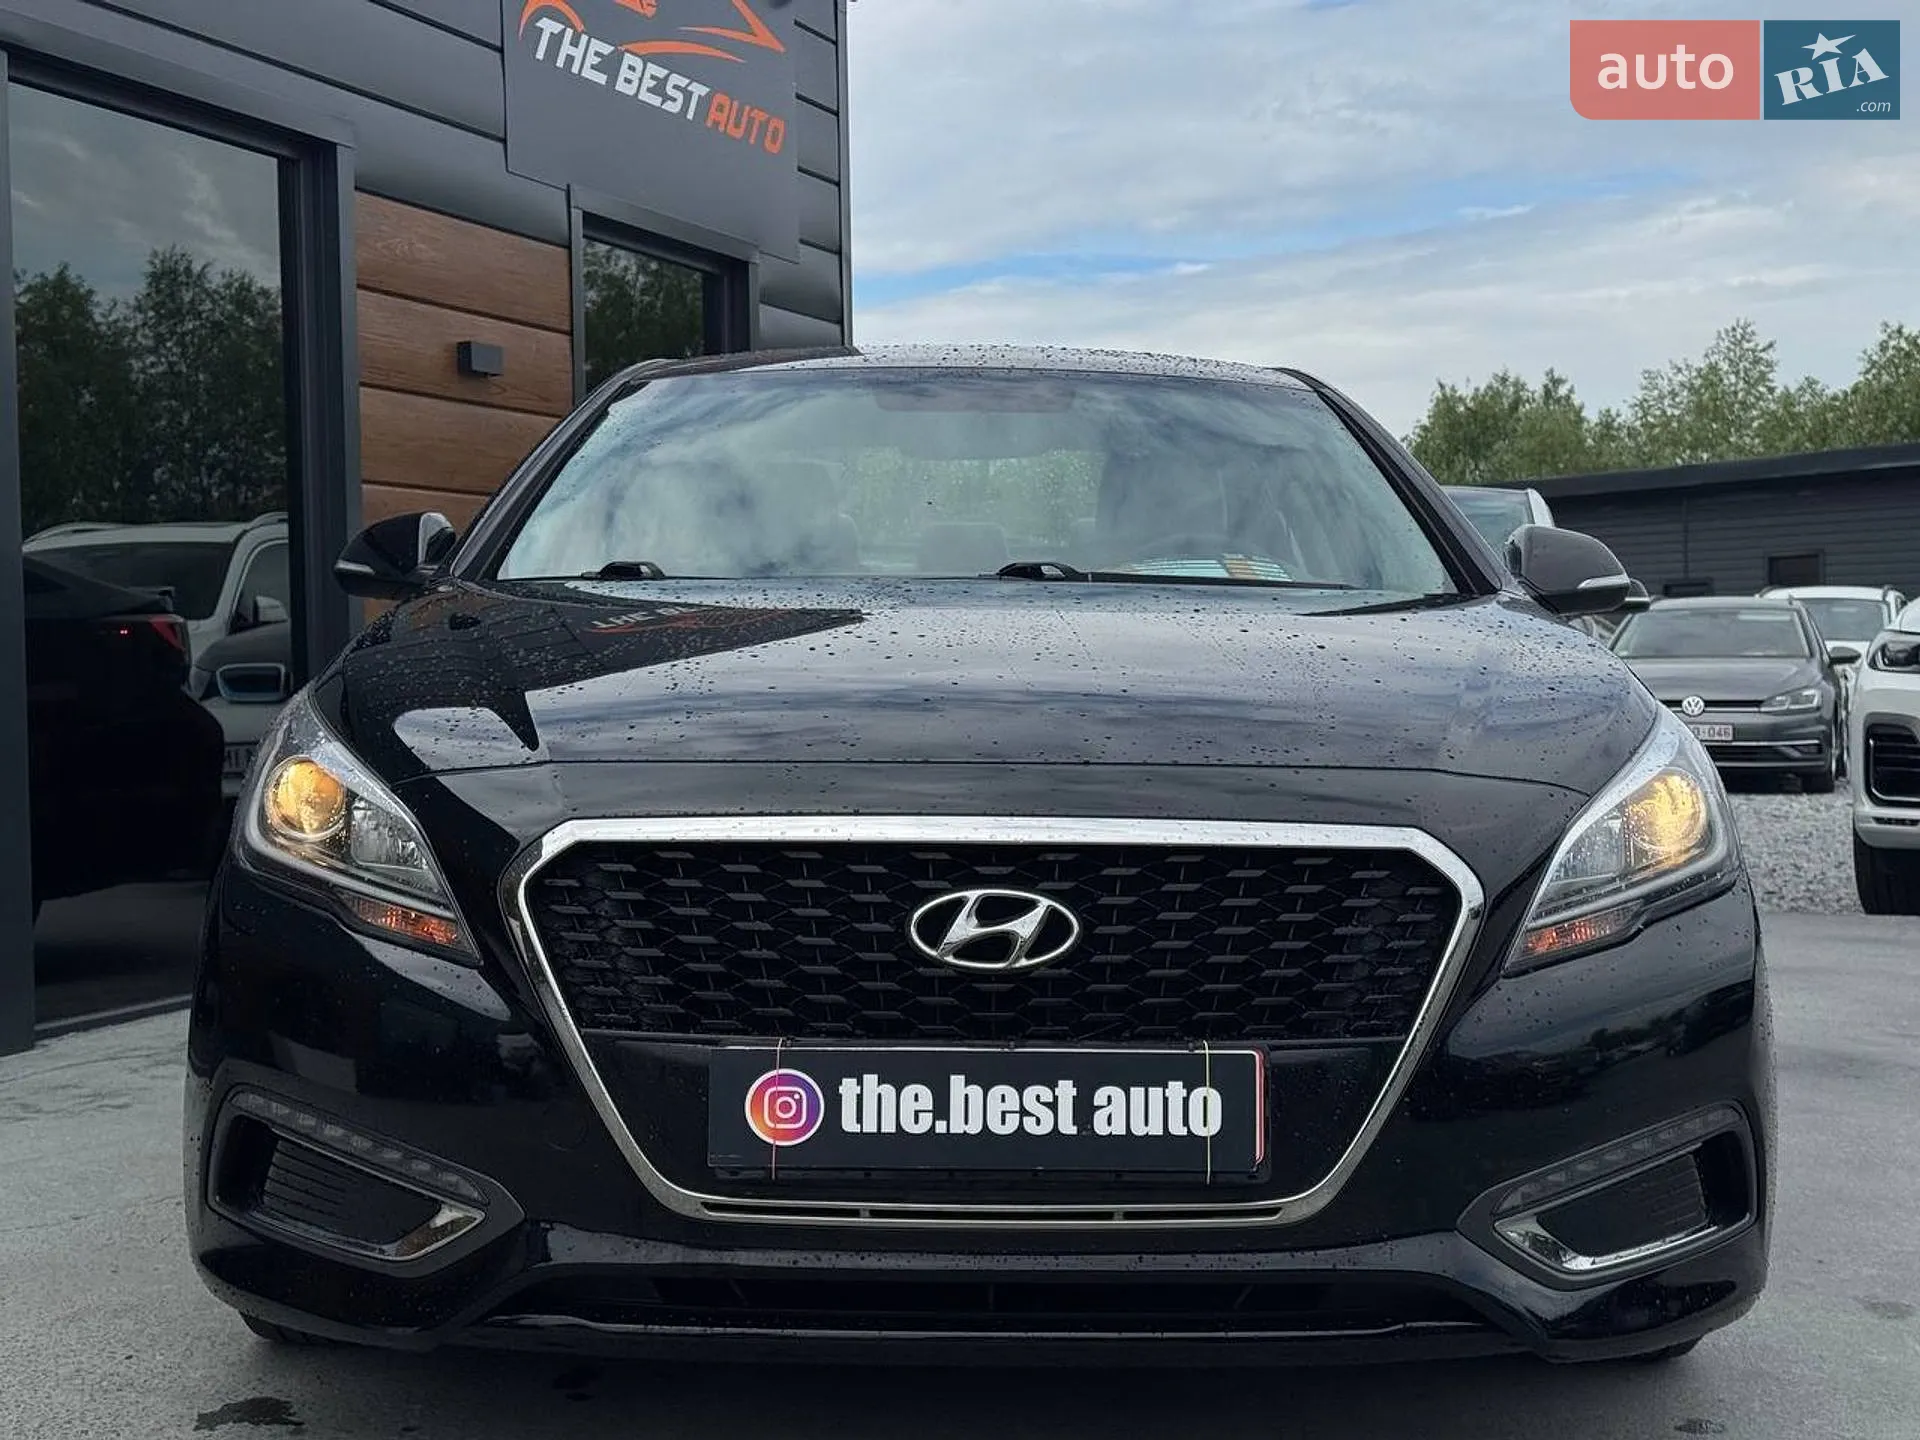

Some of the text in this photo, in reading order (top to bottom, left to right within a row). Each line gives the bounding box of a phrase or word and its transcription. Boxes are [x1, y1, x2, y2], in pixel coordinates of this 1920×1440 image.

[535, 17, 786, 154] THE BEST AUTO
[838, 1074, 1223, 1136] the.best auto
